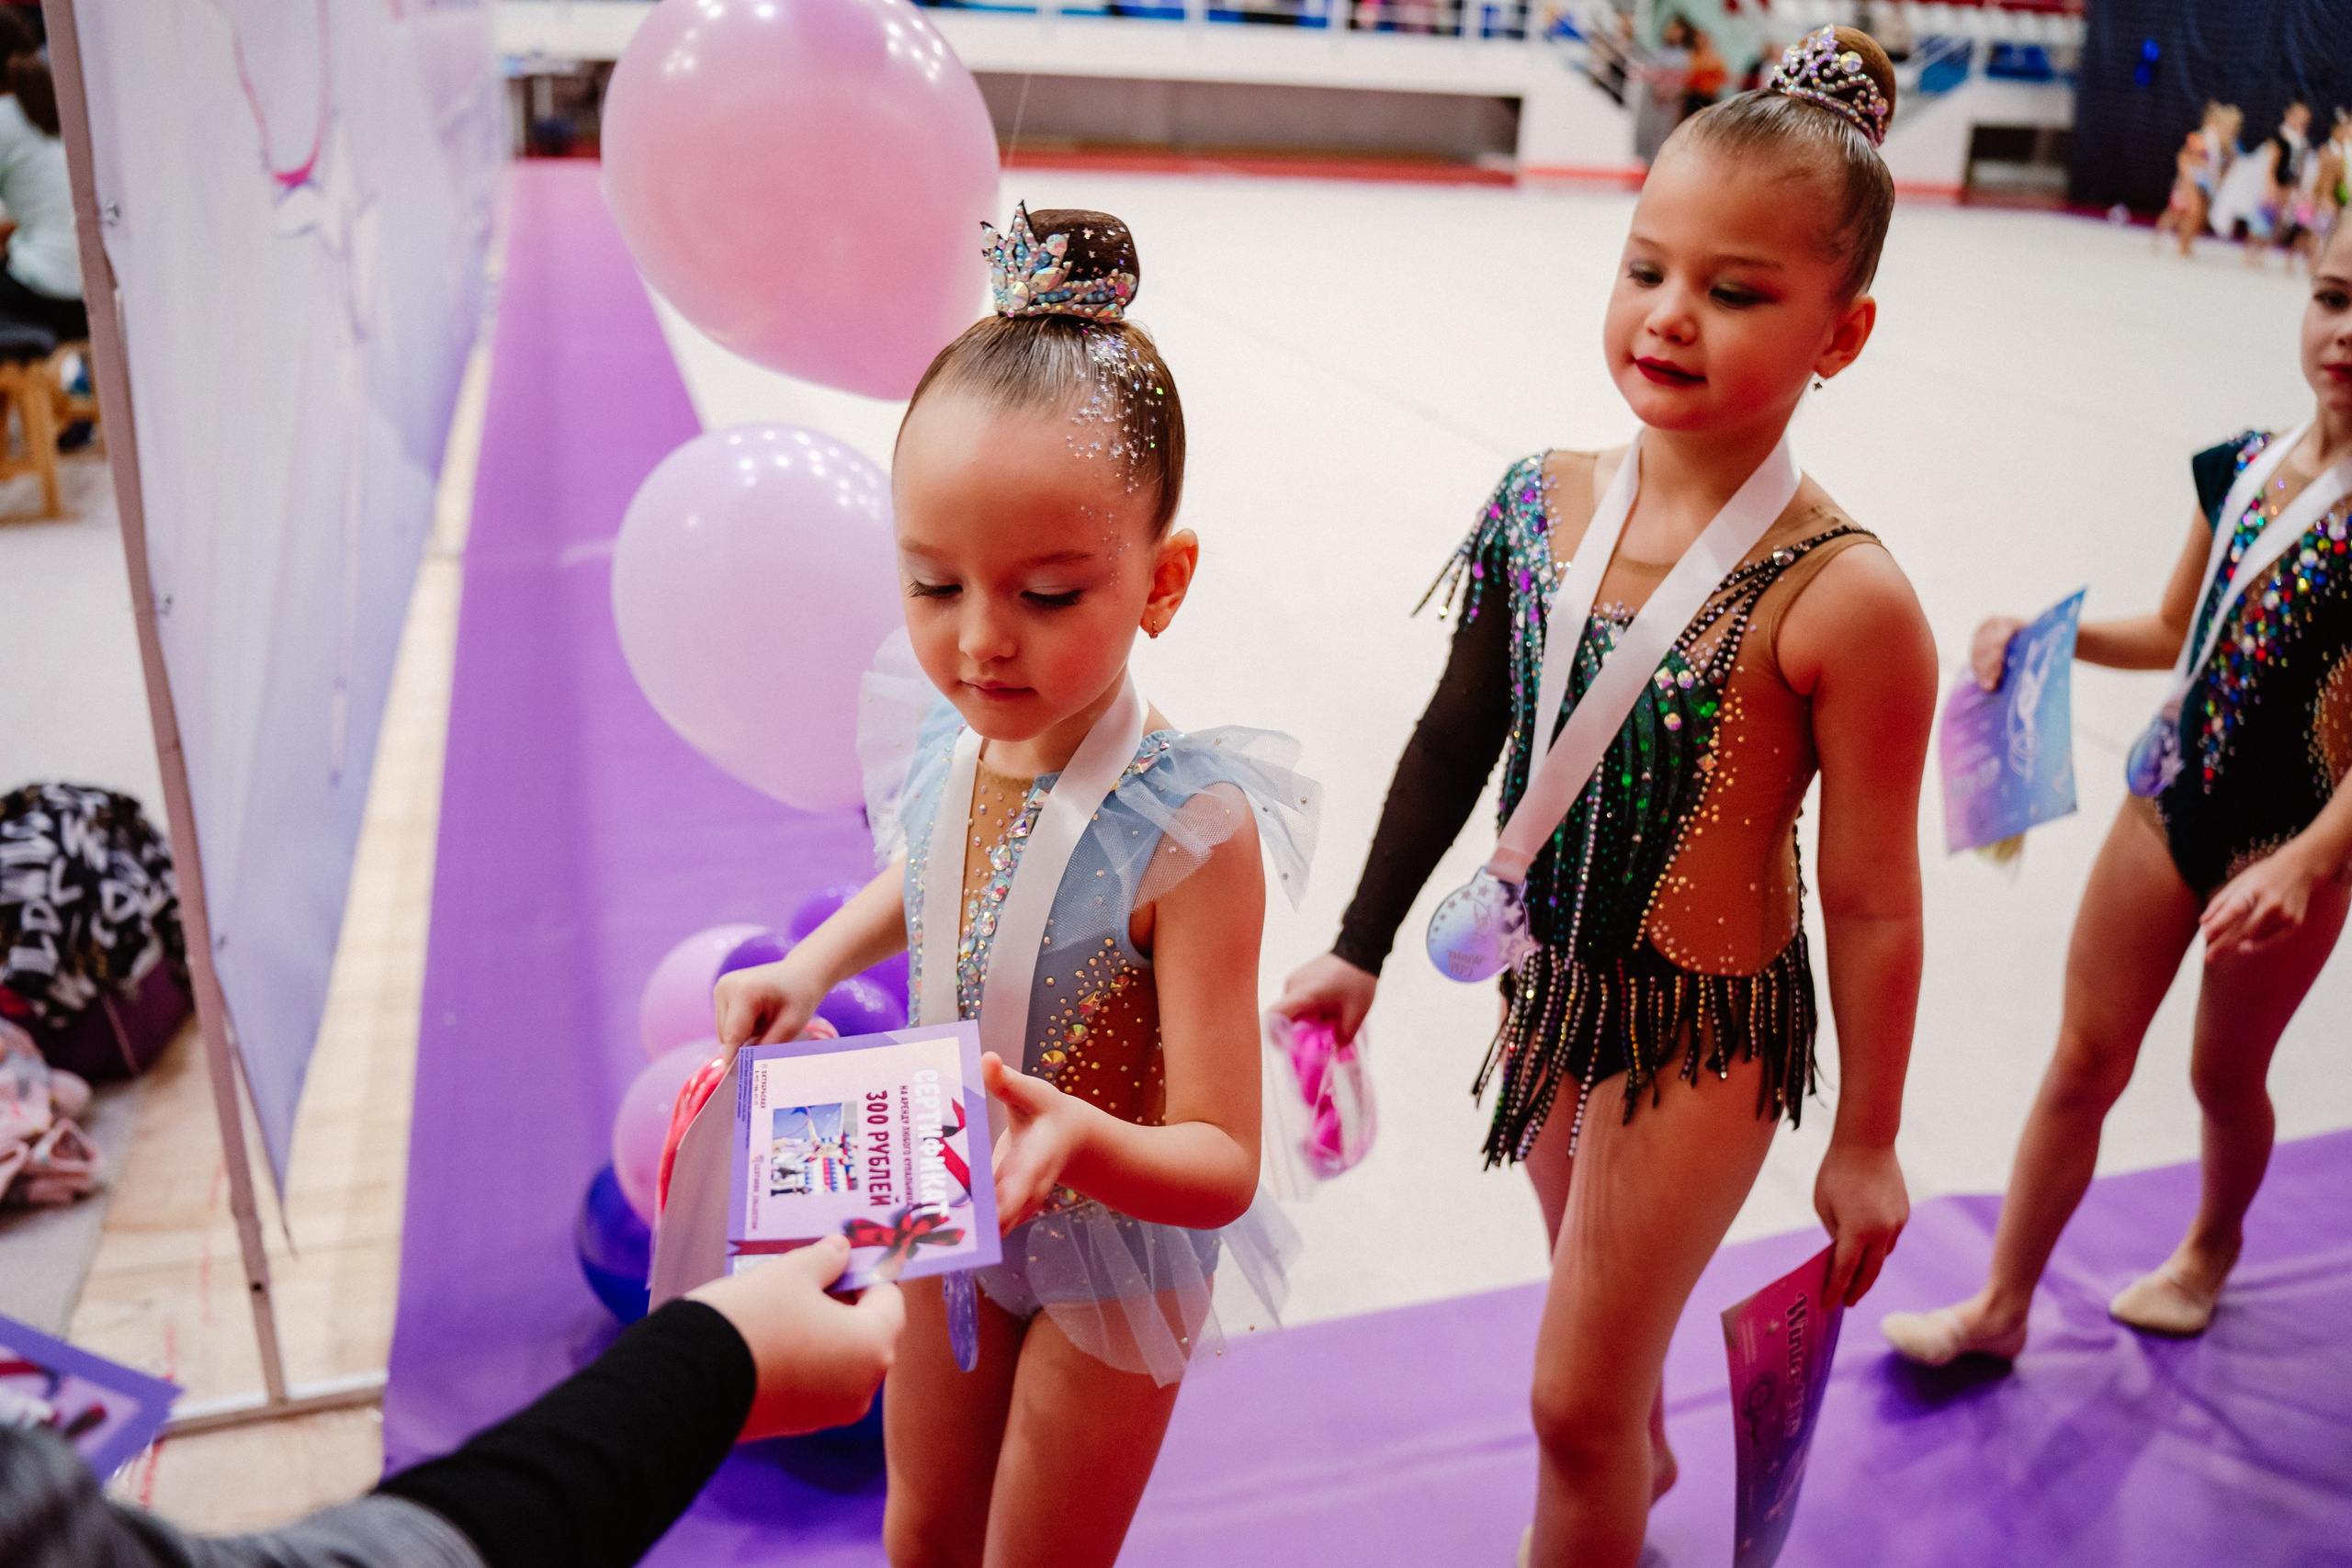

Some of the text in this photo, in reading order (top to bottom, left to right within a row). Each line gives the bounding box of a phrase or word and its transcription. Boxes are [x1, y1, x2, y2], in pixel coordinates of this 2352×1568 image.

[866, 1090, 899, 1206] 300 РУБЛЕЙ
[900, 1085, 913, 1207] НА АРЕНДУ ЛЮБОГО КУПАЛЬНИКА
[914, 1069, 950, 1215] СЕРТИФИКАТ
